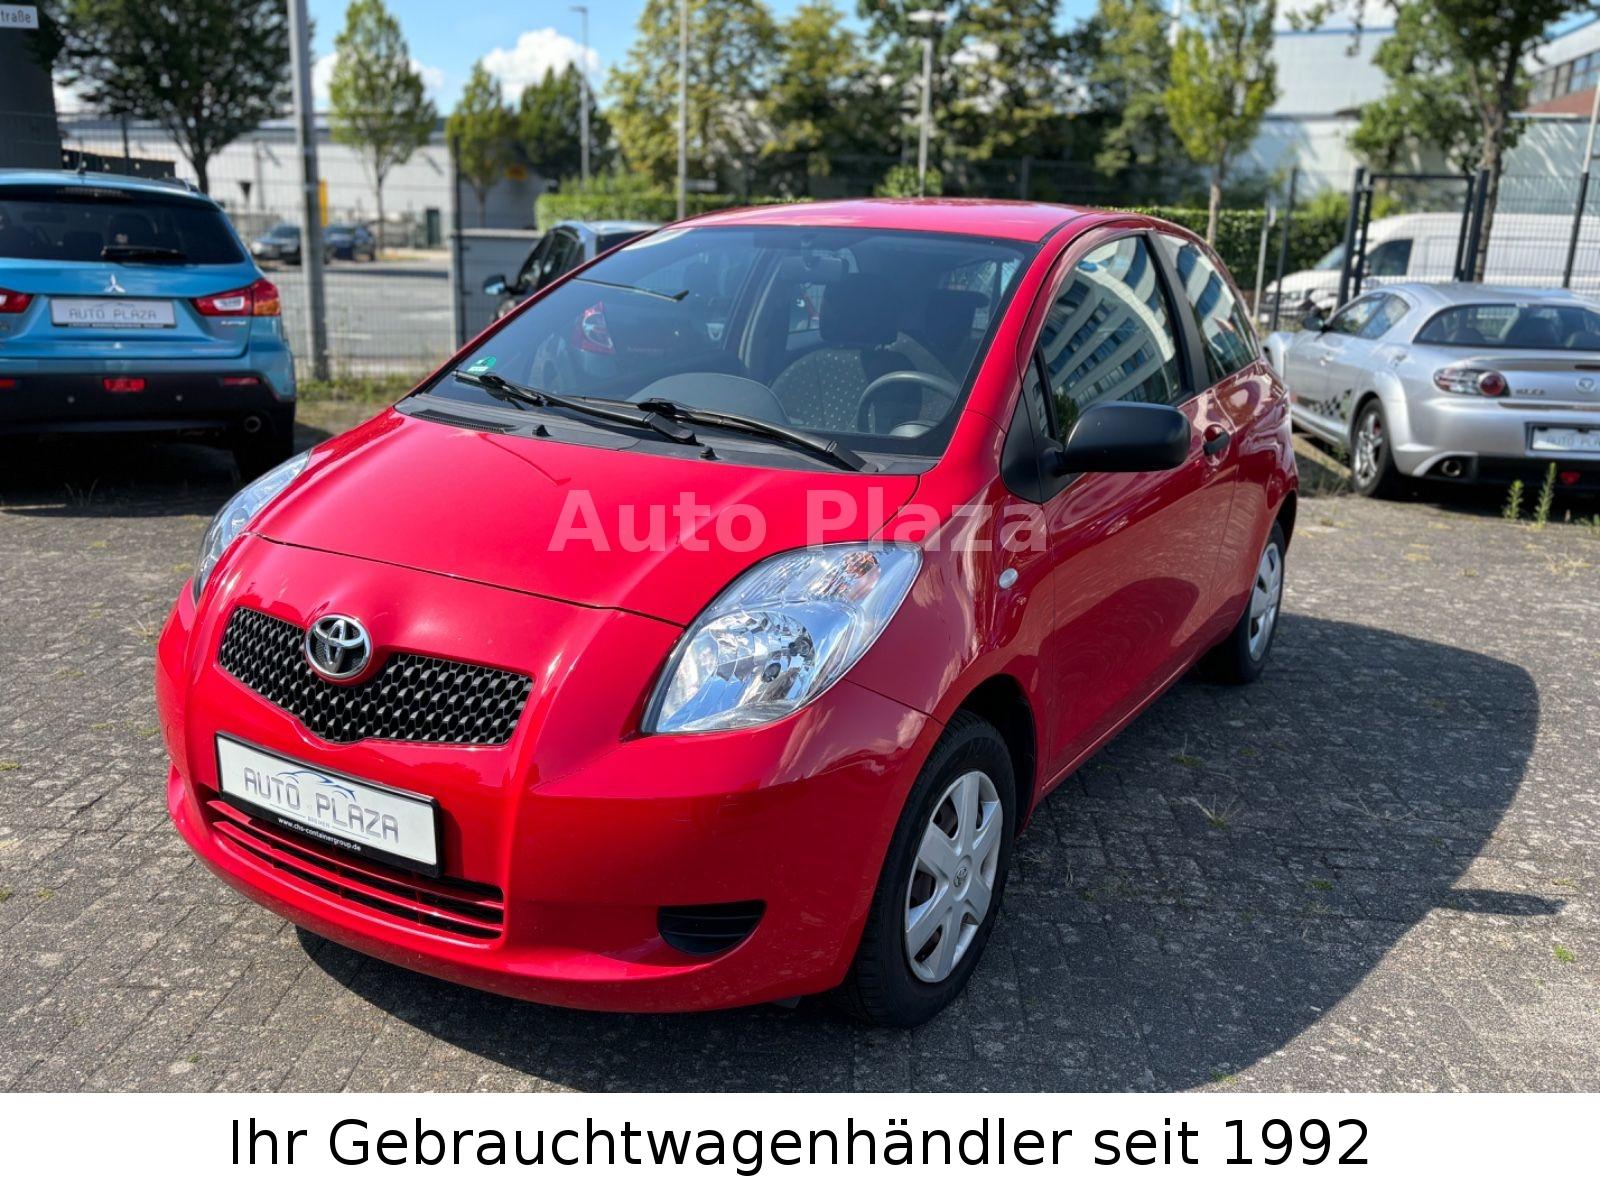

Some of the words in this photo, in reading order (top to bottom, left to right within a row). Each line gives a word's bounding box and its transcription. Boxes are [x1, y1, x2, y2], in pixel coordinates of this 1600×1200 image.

[0, 9, 32, 23] traße
[68, 308, 105, 319] AUTO
[113, 308, 157, 320] PLAZA
[243, 767, 300, 811] AUTO
[315, 792, 399, 844] PLAZA
